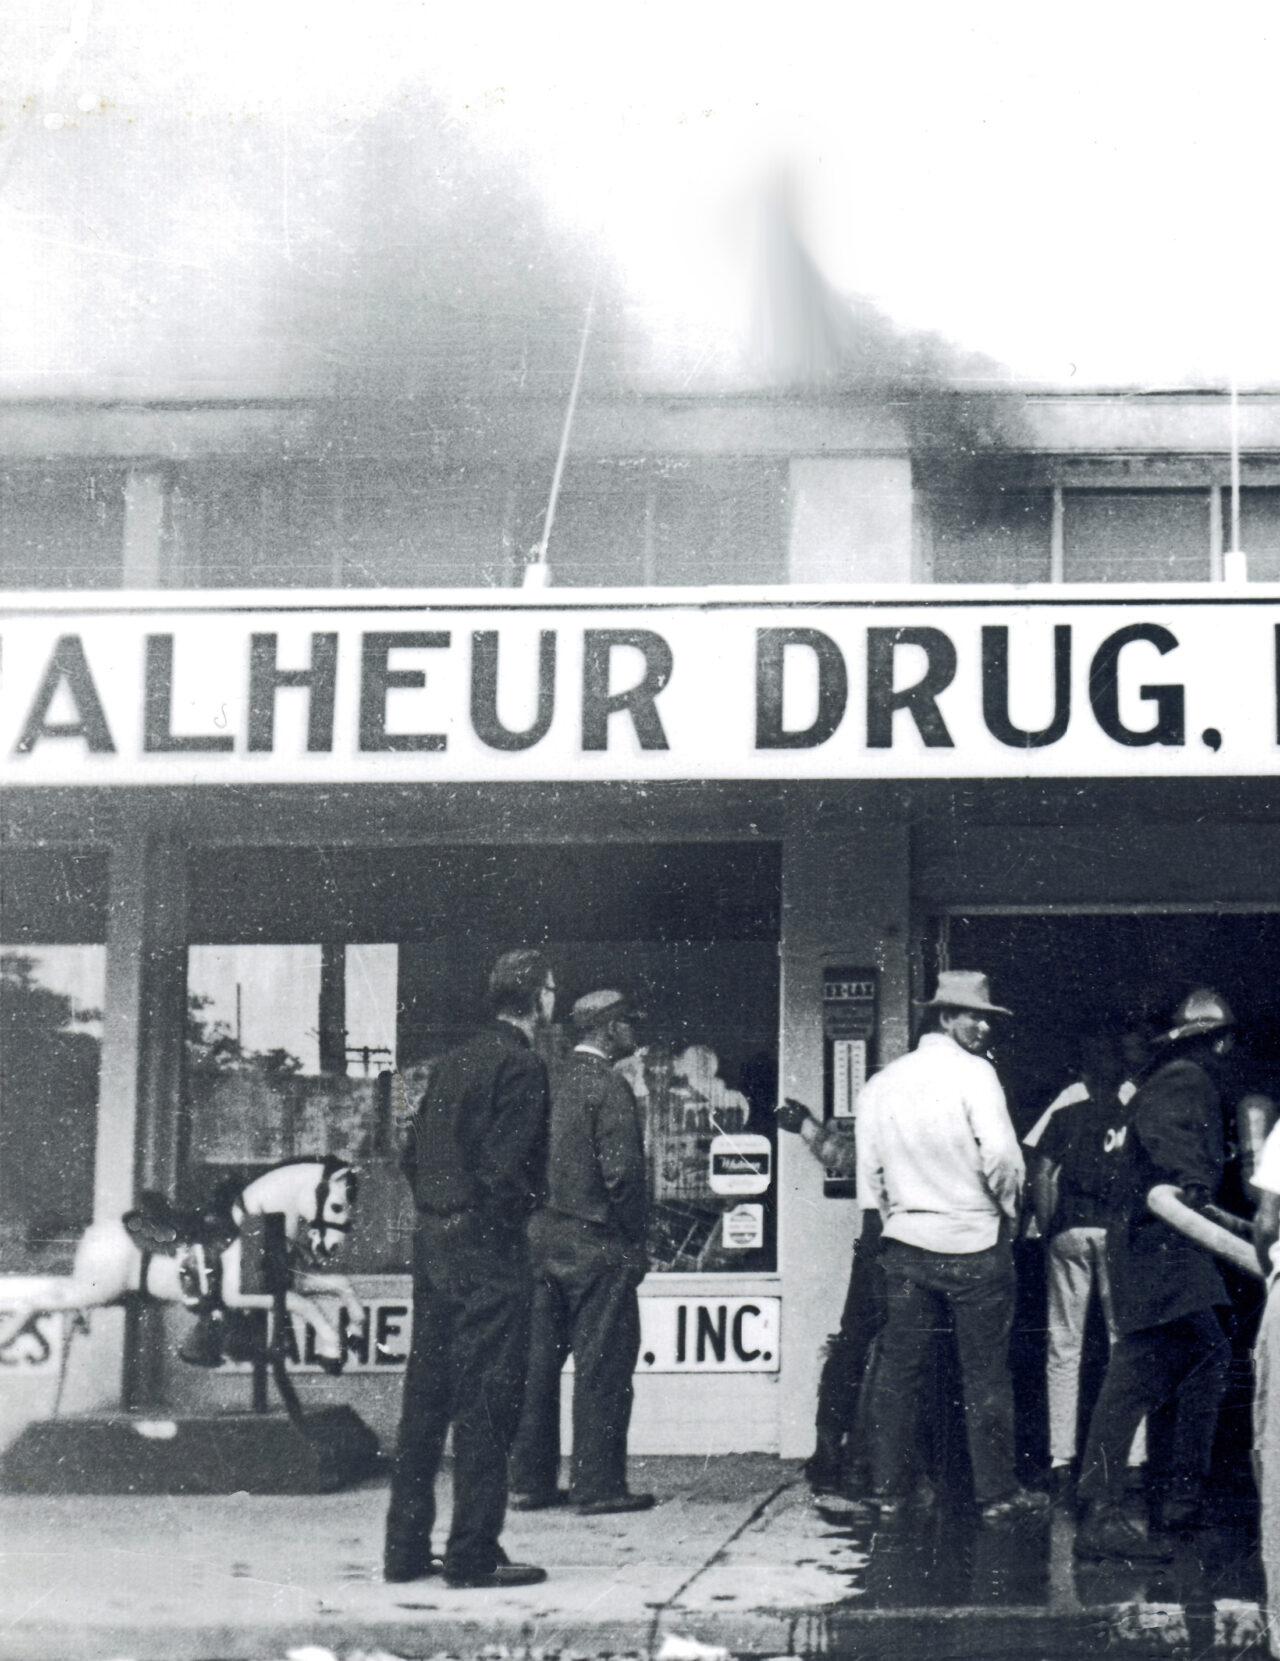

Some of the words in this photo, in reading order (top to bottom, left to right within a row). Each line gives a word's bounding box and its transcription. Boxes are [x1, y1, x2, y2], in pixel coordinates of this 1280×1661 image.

[0, 629, 673, 754] ALHEUR
[755, 622, 1223, 753] DRUG,
[676, 1304, 773, 1364] INC.
